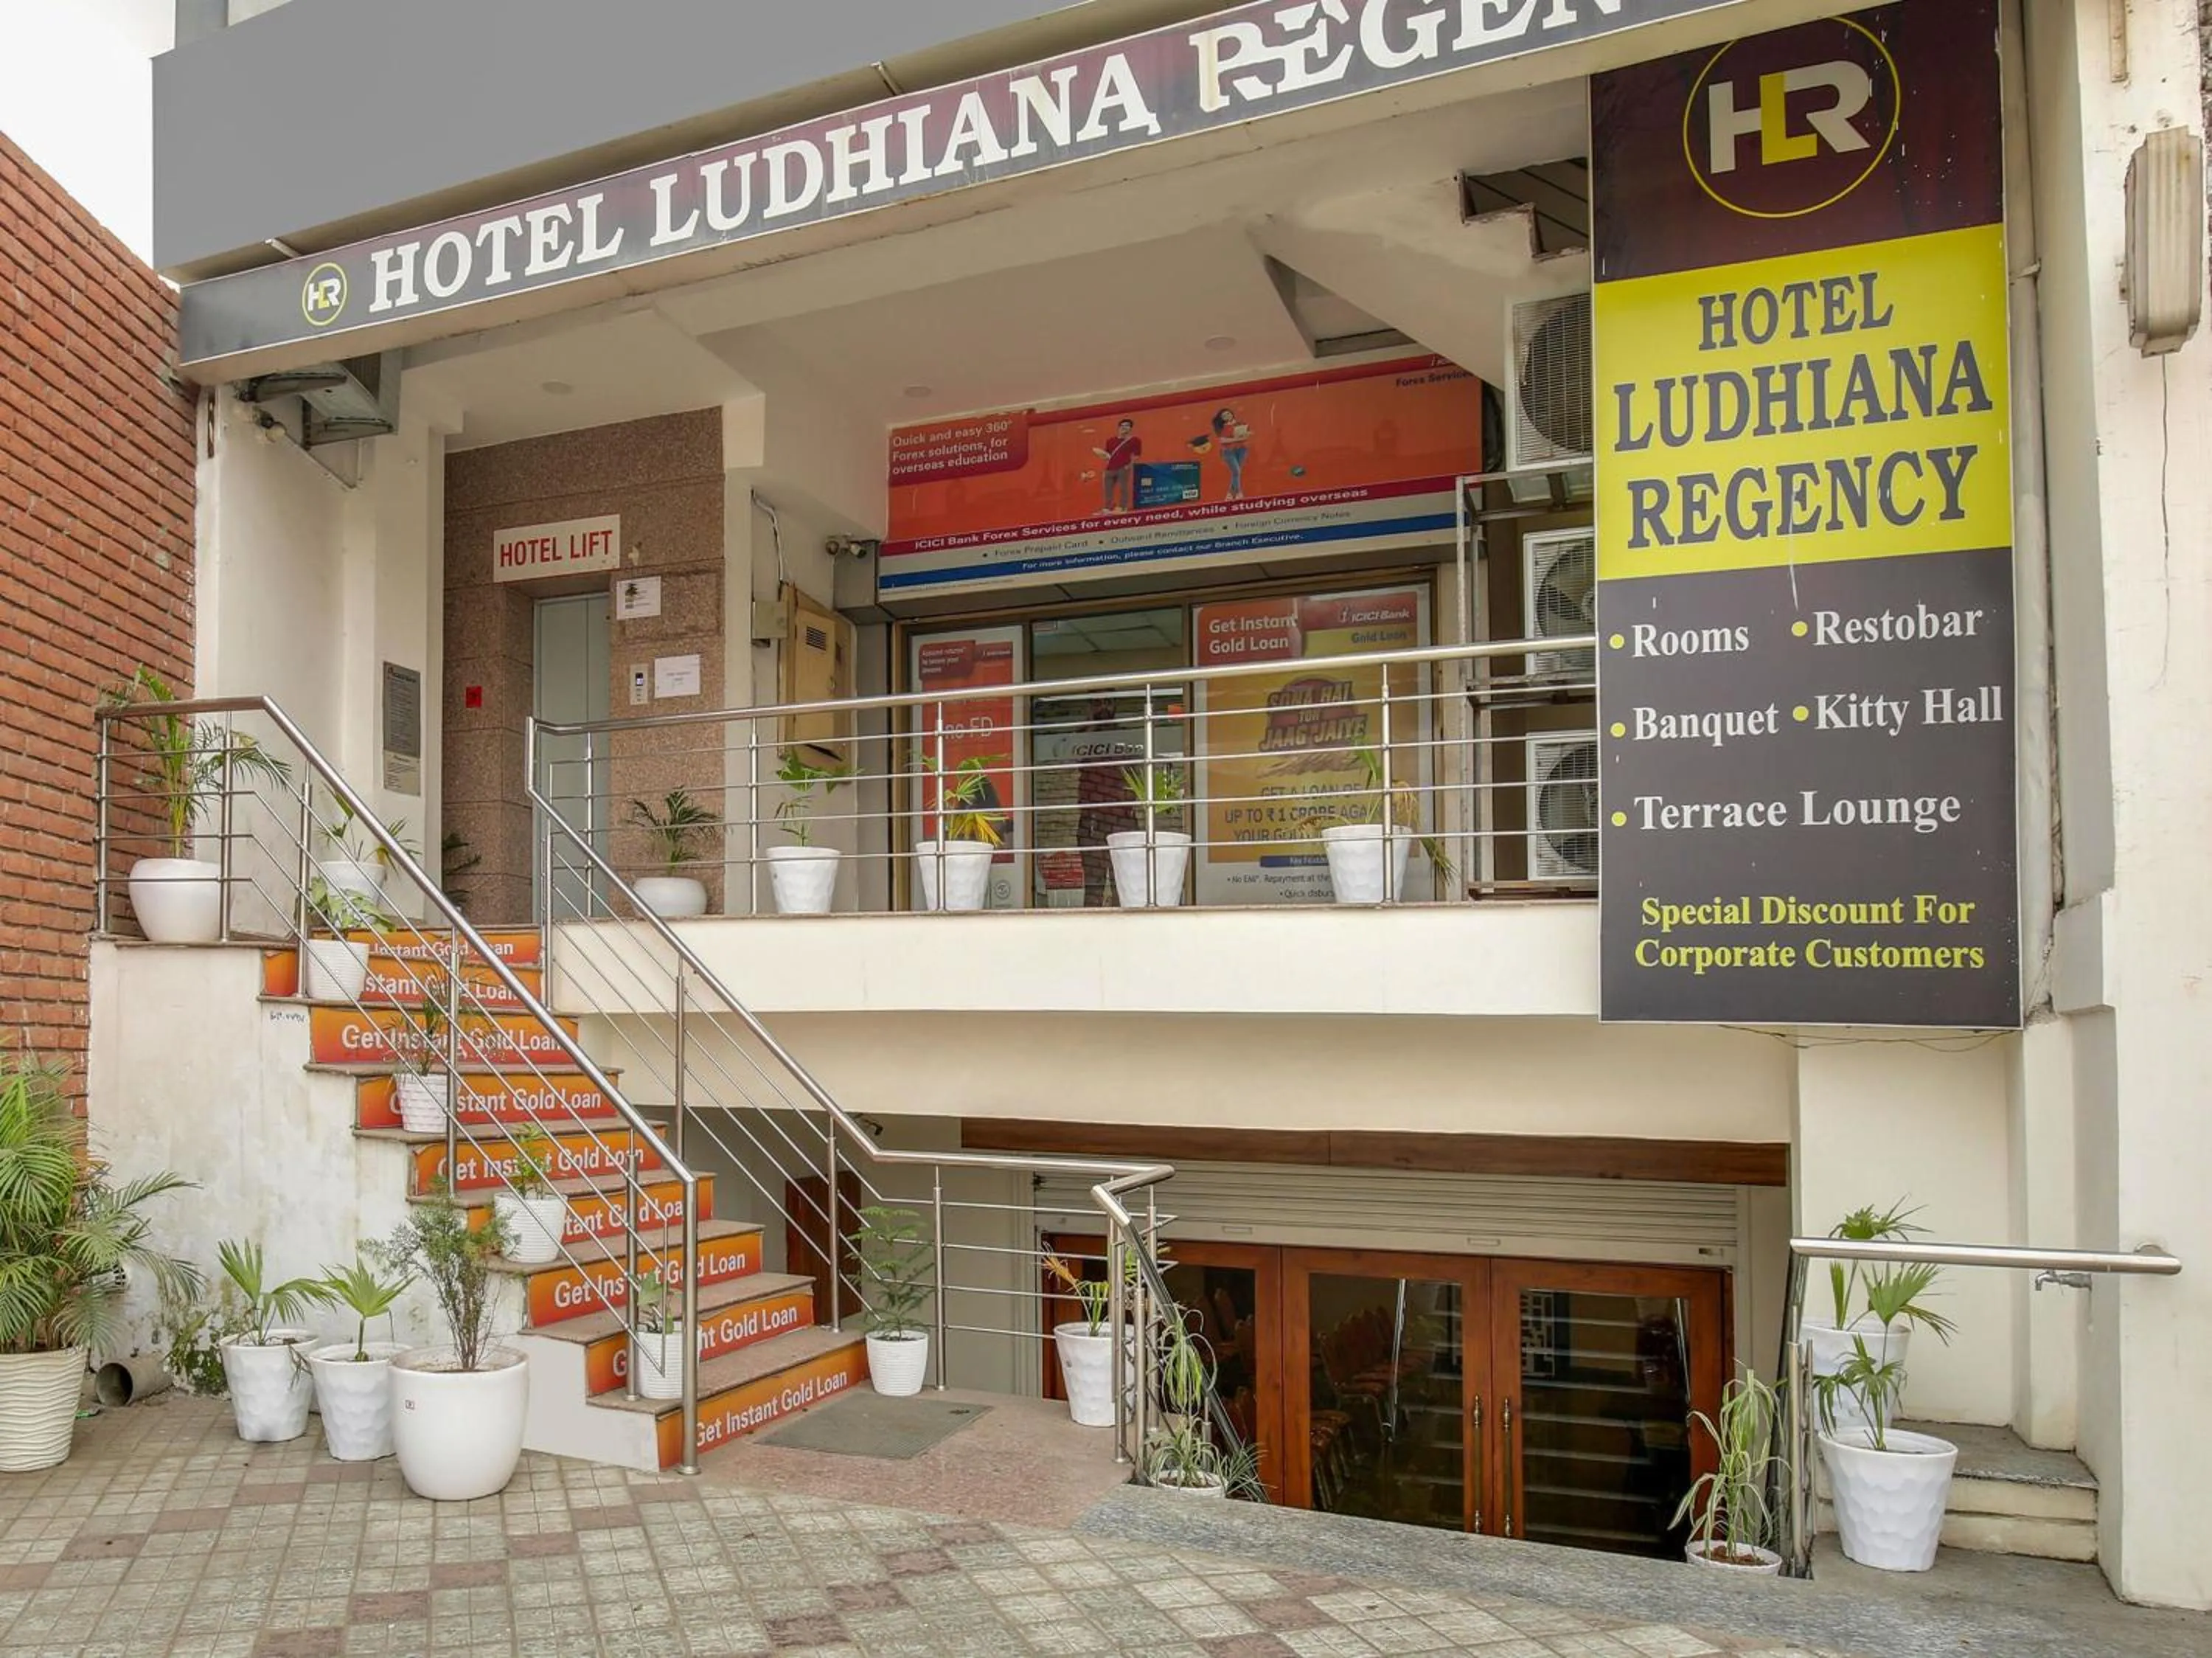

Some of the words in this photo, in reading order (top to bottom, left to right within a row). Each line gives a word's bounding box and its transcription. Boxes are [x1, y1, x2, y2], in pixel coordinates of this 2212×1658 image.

[369, 193, 624, 314] HOTEL
[650, 54, 1163, 246] LUDHIANA
[1698, 272, 1893, 351] HOTEL
[1613, 340, 1993, 453] LUDHIANA
[893, 434, 926, 448] Quick
[929, 429, 952, 443] and
[955, 426, 983, 437] easy
[893, 450, 925, 462] Forex
[928, 442, 987, 456] solutions,
[990, 437, 1008, 447] for
[893, 461, 945, 475] overseas
[947, 451, 1008, 468] education
[1627, 445, 1978, 549] REGENCY
[915, 538, 945, 549] ICICI
[947, 535, 980, 544] Bank
[983, 530, 1018, 541] Forex
[1022, 523, 1077, 537] Services
[1080, 519, 1101, 530] for
[1104, 515, 1142, 527] every
[1145, 510, 1183, 521] need,
[1188, 504, 1228, 516] while
[1230, 496, 1296, 512] studying
[1300, 488, 1369, 504] overseas
[500, 536, 563, 567] HOTEL
[569, 530, 613, 560] LIFT
[1208, 619, 1237, 634] Get
[1241, 614, 1297, 631] Instant
[1632, 623, 1750, 658] Rooms
[1812, 604, 1984, 647] Restobar
[1208, 637, 1245, 655] Gold
[1250, 636, 1289, 651] Loan
[1632, 702, 1780, 747] Banquet
[1814, 693, 1910, 736] Kitty
[1921, 685, 2004, 726] Hall
[1114, 742, 1144, 755] Ban
[1225, 808, 1242, 824] UP
[1246, 808, 1263, 823] TO
[1634, 795, 1788, 830] Terrace
[1799, 790, 1961, 833] Lounge
[1641, 895, 1753, 933] Special
[1759, 895, 1905, 925] Discount
[1913, 894, 1976, 924] For
[433, 940, 469, 957] God
[1635, 939, 1796, 974] Corporate
[1805, 938, 1985, 970] Customers
[341, 1024, 383, 1050] Get
[470, 1027, 513, 1051] Gold
[512, 1088, 555, 1110] Gold
[563, 1087, 602, 1110] Loan
[557, 1146, 599, 1172] Gold
[554, 1280, 591, 1308] Get
[709, 1252, 746, 1275] Loan
[720, 1311, 758, 1344] Gold
[762, 1306, 798, 1331] Loan
[726, 1396, 779, 1435] Instant
[782, 1380, 813, 1412] Gold
[816, 1370, 848, 1396] Loan
